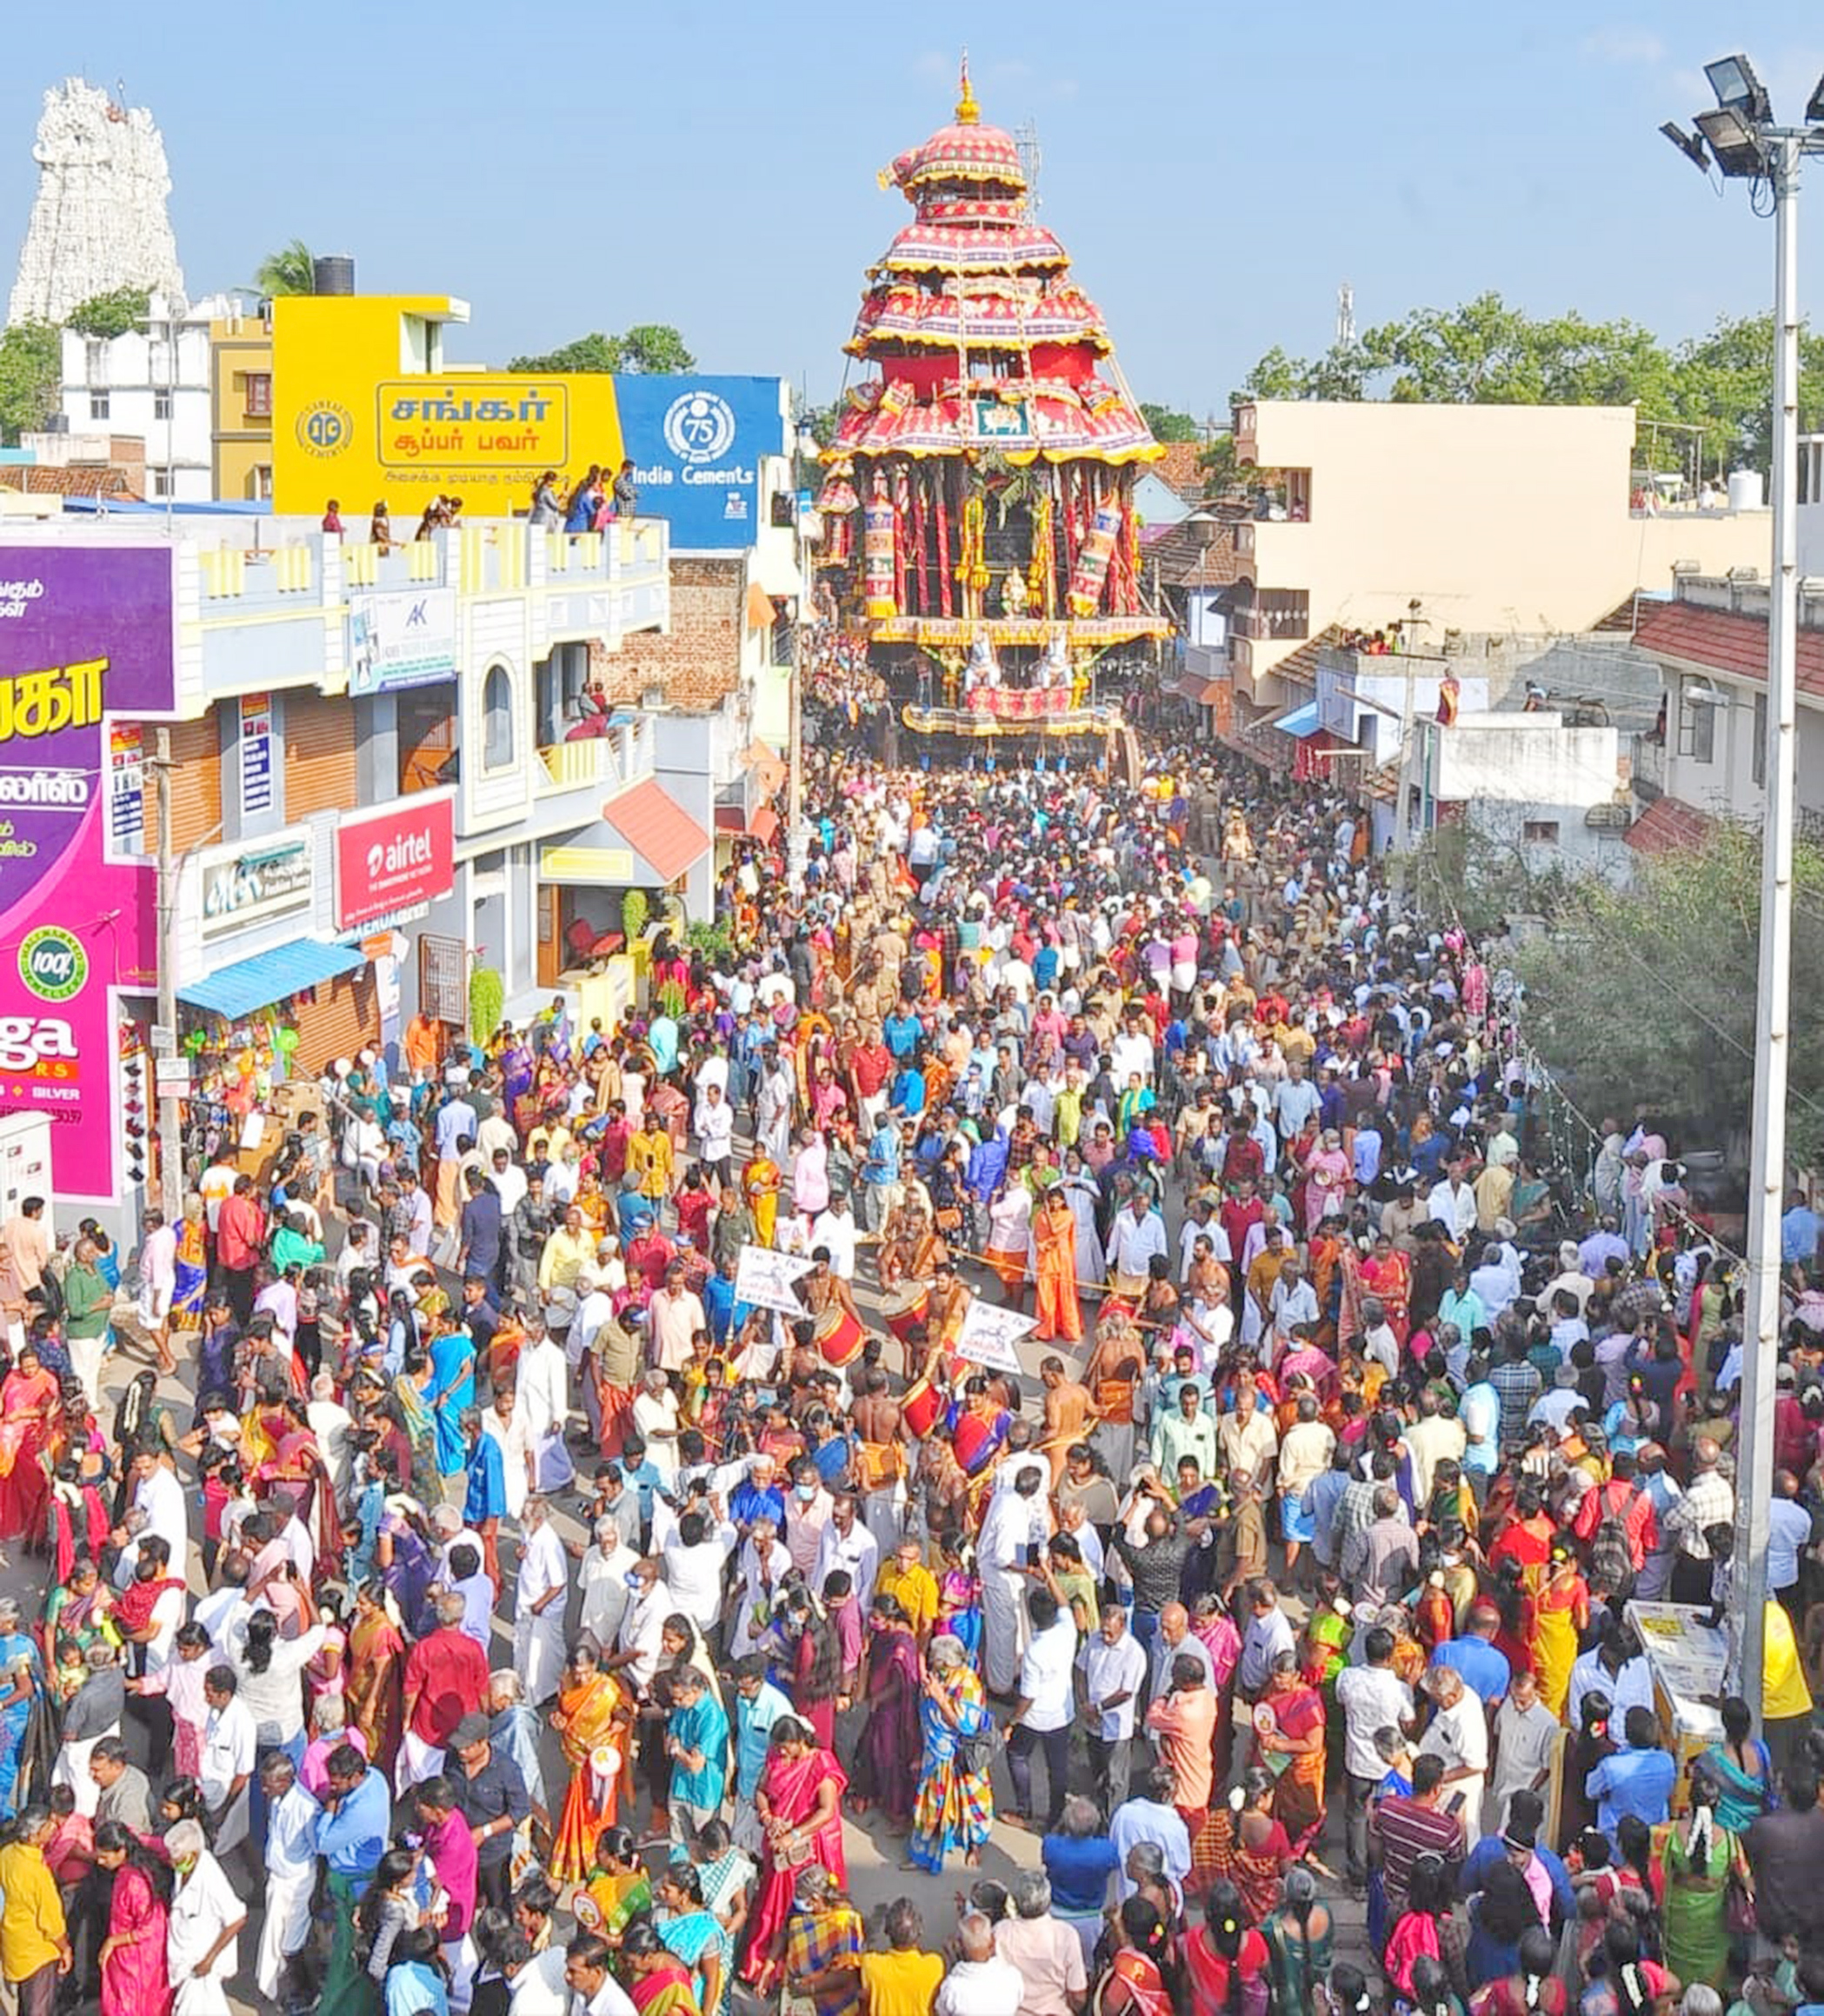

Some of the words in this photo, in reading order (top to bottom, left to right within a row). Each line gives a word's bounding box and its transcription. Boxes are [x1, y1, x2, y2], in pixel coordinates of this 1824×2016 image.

[391, 390, 552, 422] சங்கர்
[394, 428, 463, 456] சூப்பர்
[478, 428, 539, 450] பவர்
[685, 420, 714, 443] 75
[633, 466, 673, 484] India
[682, 465, 754, 484] Cements
[406, 599, 427, 627] AK
[386, 828, 432, 872] airtel
[33, 951, 72, 981] 100%
[32, 1086, 80, 1101] SILVER
